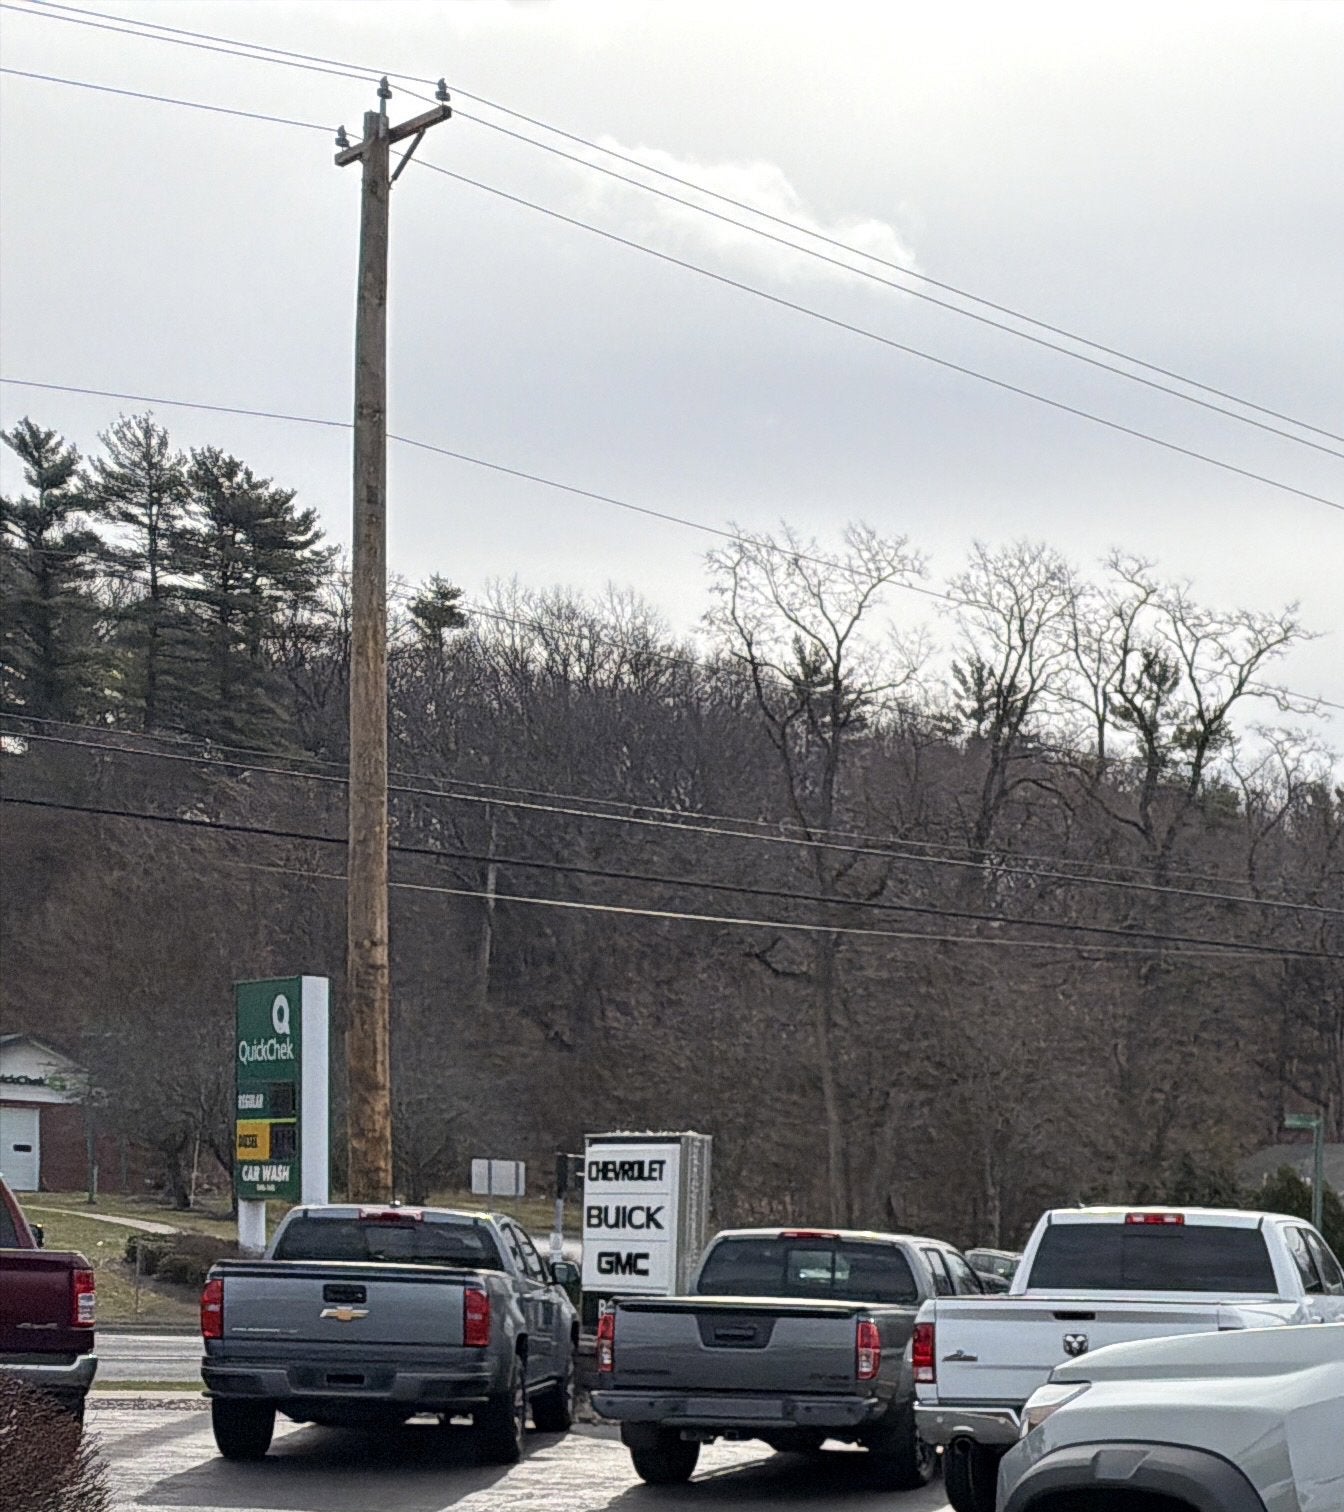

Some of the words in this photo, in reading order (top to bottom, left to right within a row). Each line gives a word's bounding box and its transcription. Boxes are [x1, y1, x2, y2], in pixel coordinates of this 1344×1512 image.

[272, 994, 290, 1035] Q
[239, 1038, 294, 1066] QuickChek
[241, 1164, 260, 1181] CAR
[262, 1164, 290, 1182] WASH
[588, 1159, 667, 1182] CHEVROLET
[586, 1204, 666, 1230] BUICK
[596, 1251, 650, 1276] GMC
